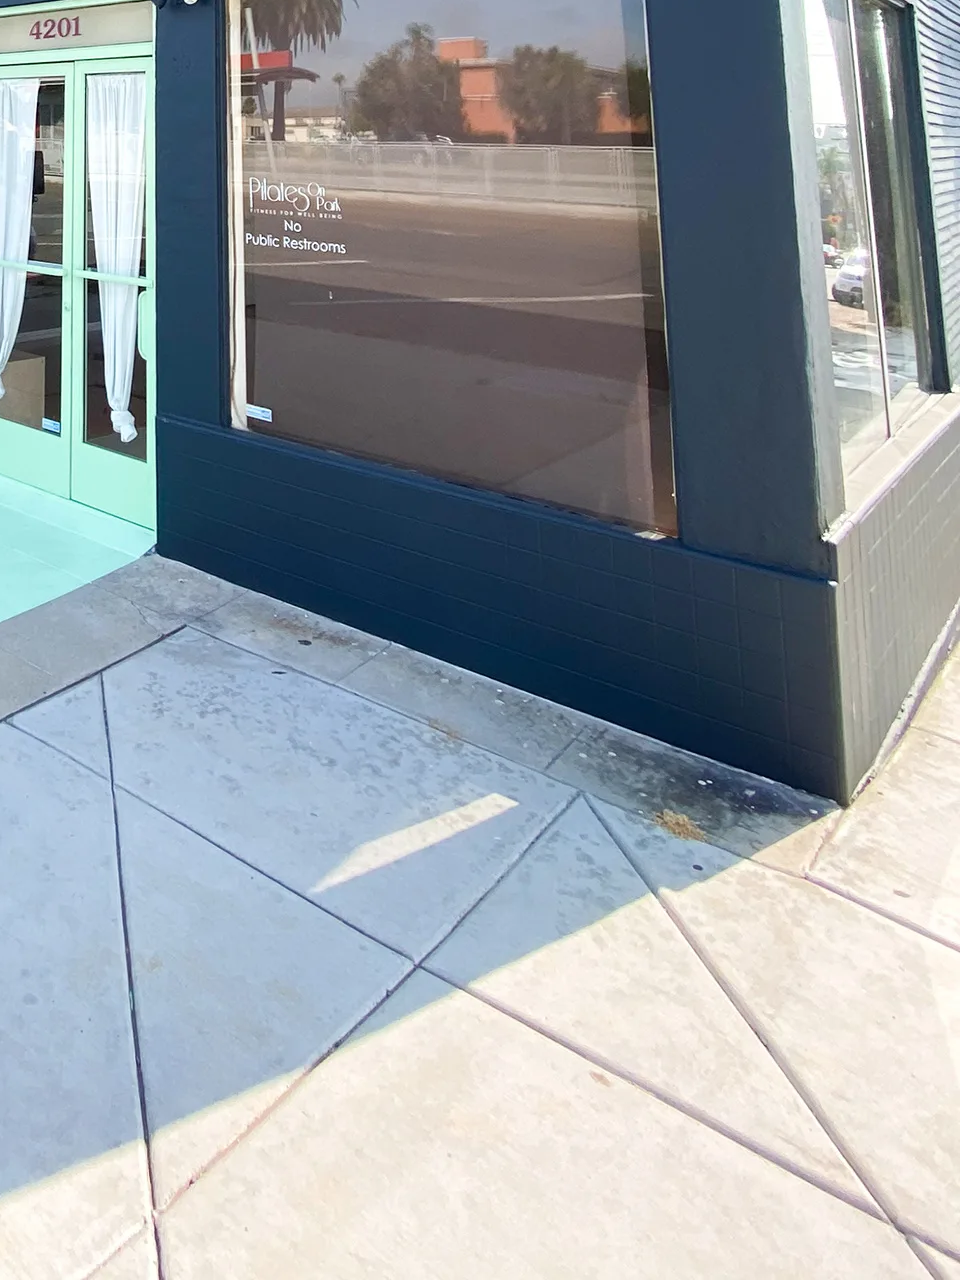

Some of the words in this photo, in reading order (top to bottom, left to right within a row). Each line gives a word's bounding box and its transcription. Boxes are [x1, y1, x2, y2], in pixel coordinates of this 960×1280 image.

[29, 16, 82, 40] 4201
[249, 177, 310, 212] Pilates
[307, 182, 325, 197] On
[316, 196, 342, 211] Park
[283, 220, 302, 232] No
[245, 233, 280, 247] Public
[283, 236, 347, 254] Restrooms
